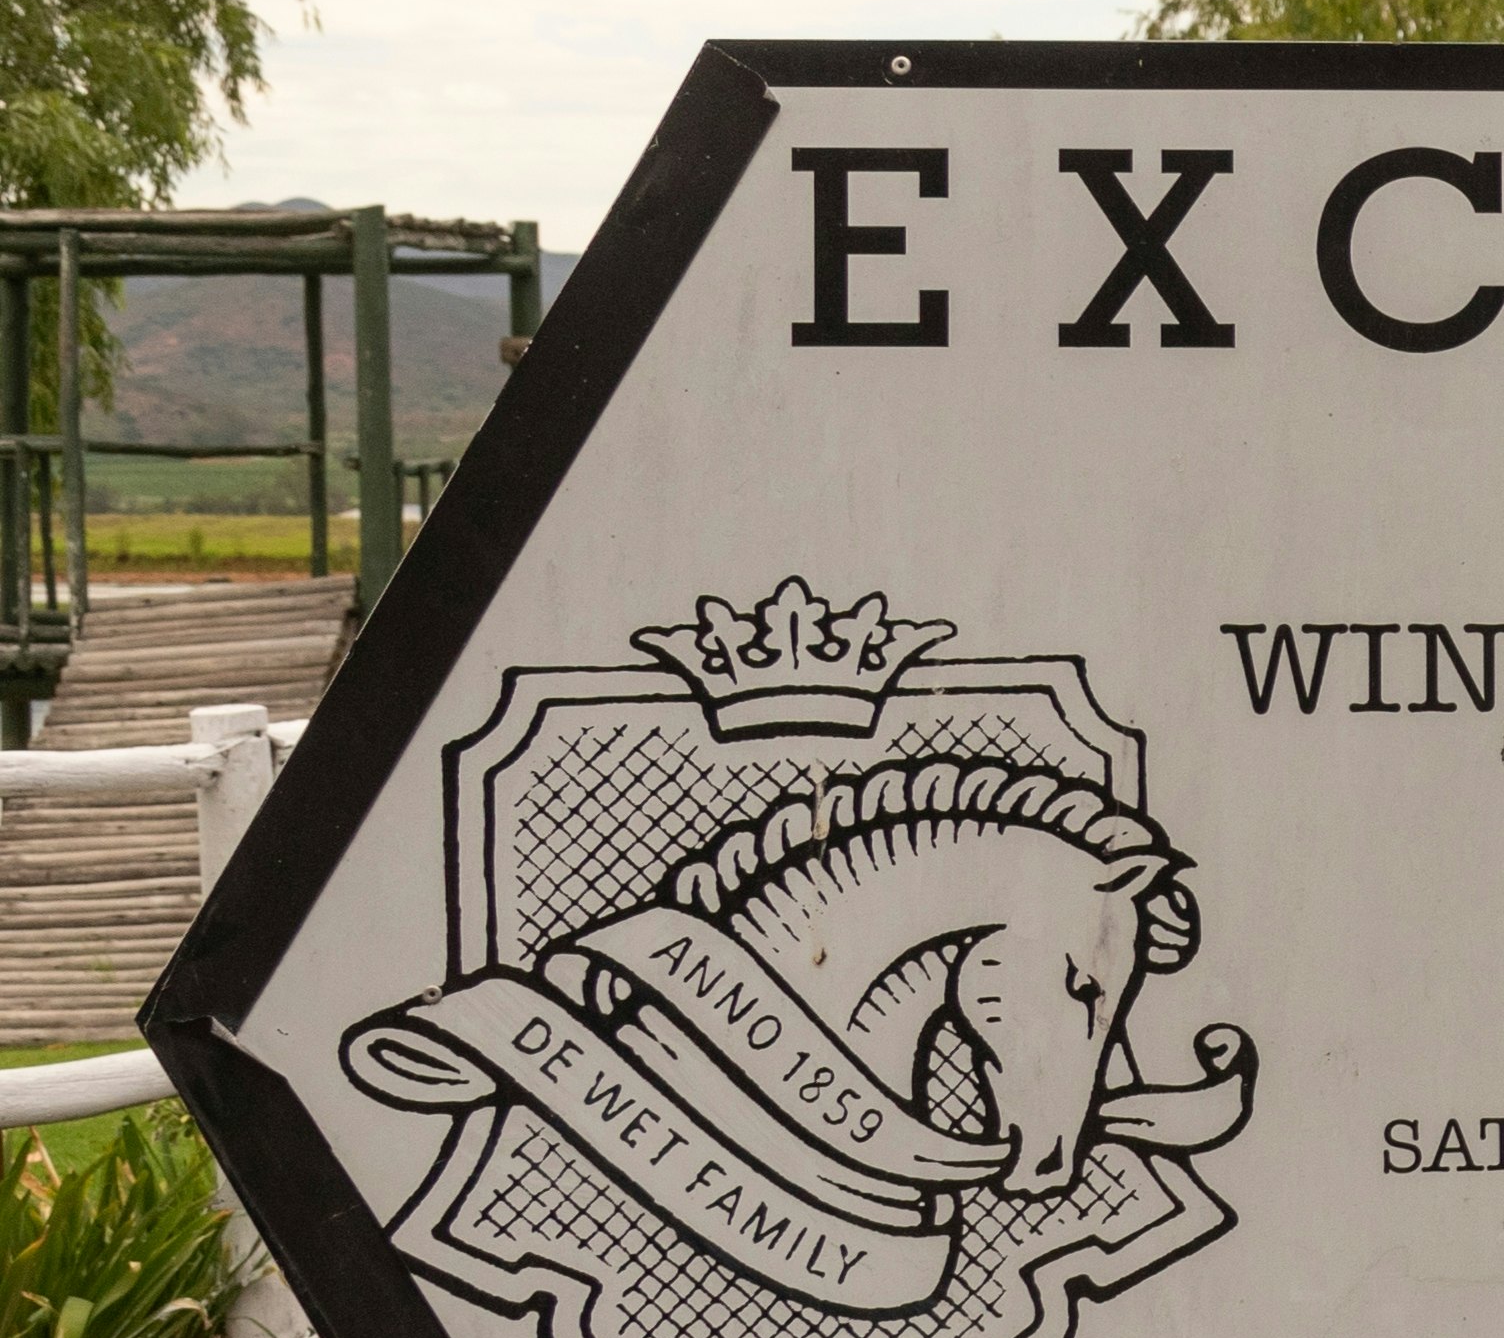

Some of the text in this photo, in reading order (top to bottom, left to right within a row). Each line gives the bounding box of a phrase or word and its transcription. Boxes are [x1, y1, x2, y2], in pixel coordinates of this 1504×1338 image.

[511, 1017, 867, 1284] DE WET FAMILY
[649, 936, 884, 1143] ANNO 1859
